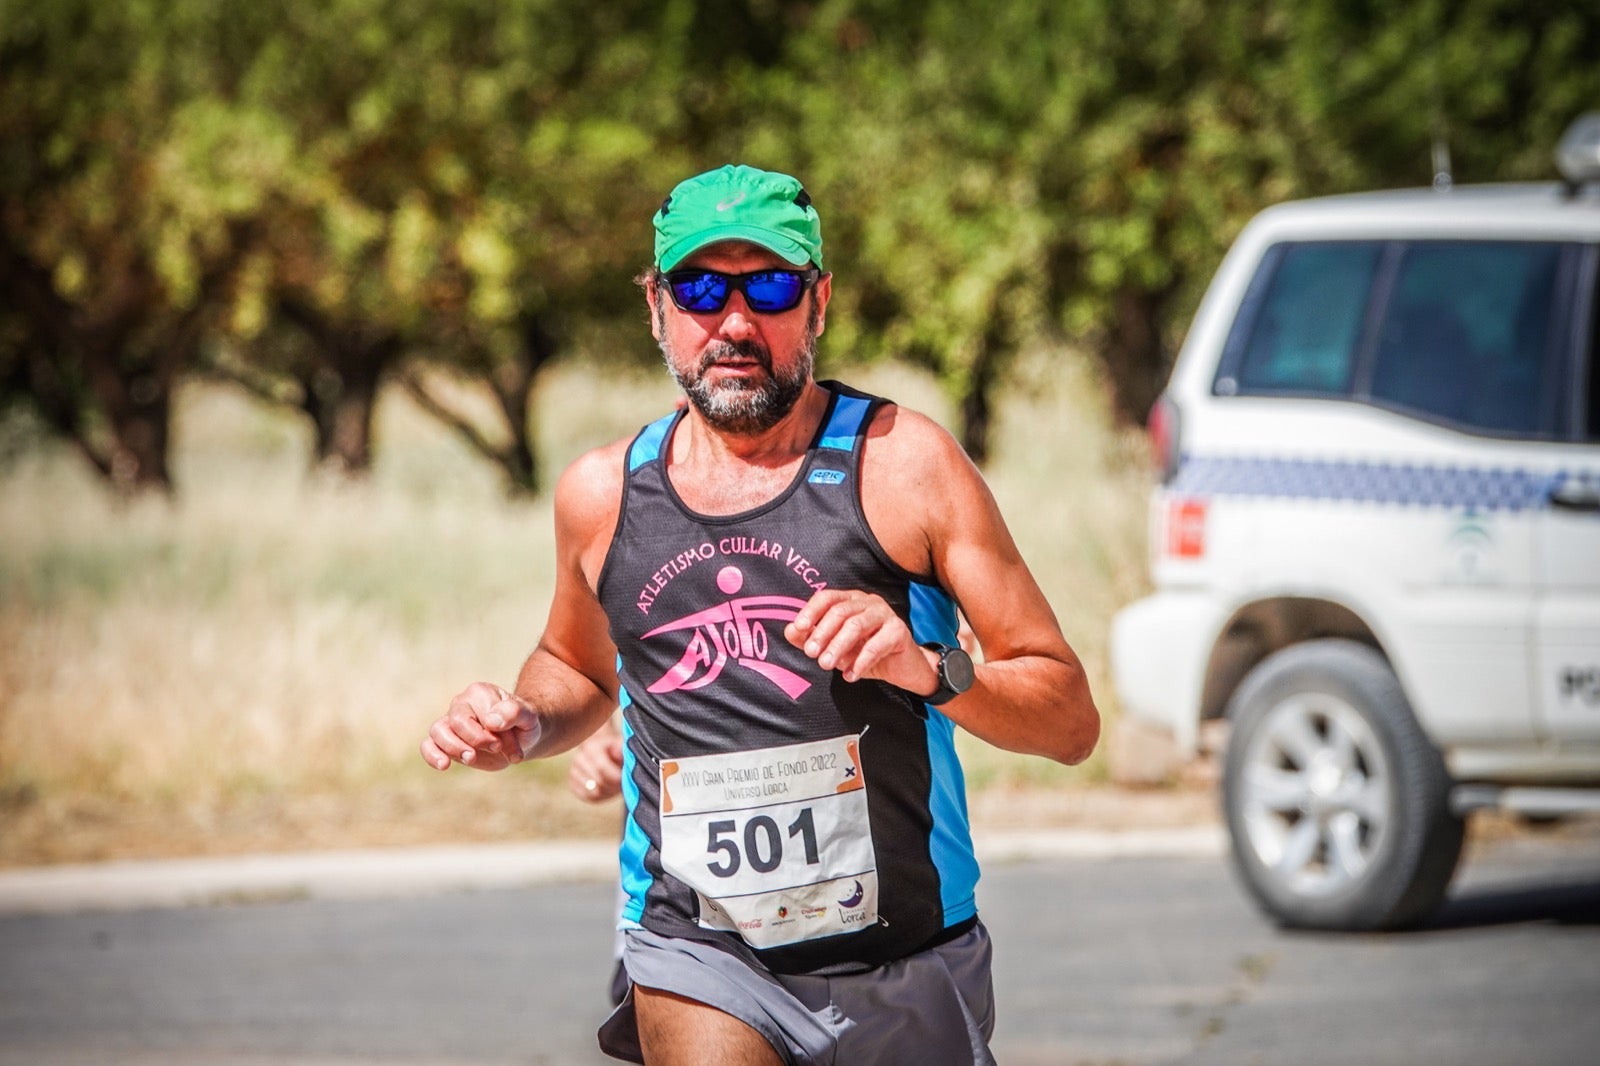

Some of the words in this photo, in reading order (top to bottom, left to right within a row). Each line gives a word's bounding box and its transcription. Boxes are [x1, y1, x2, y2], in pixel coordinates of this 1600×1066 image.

[636, 542, 716, 616] ATLETISMO
[719, 536, 783, 561] CULLAR
[785, 547, 828, 593] VEGA
[703, 769, 725, 786] GRAN
[726, 767, 760, 783] PREMIO
[762, 765, 775, 780] DE
[777, 760, 808, 777] FONDO
[810, 752, 838, 772] 2022
[723, 785, 761, 801] UNIVERSO
[762, 782, 789, 797] LORCA
[707, 807, 820, 878] 501
